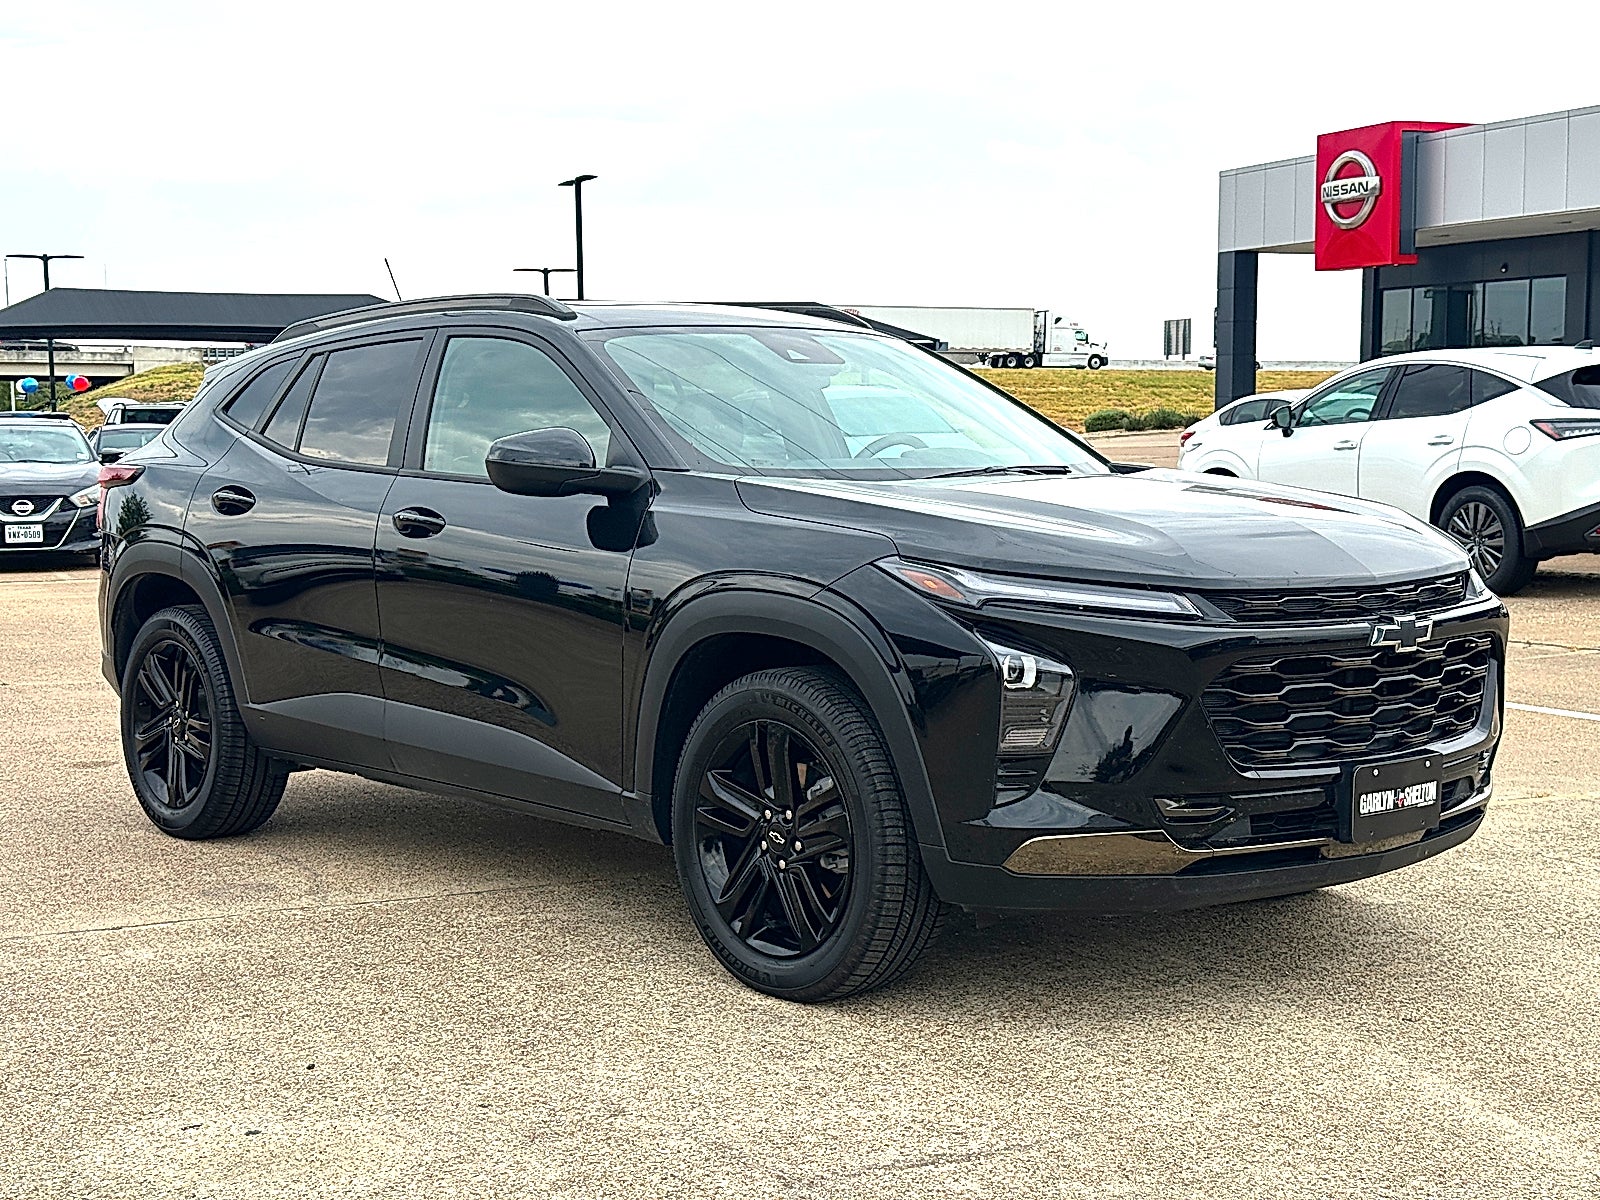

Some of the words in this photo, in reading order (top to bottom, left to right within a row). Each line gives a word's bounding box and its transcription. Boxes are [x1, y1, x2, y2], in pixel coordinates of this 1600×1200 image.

[1322, 181, 1369, 198] NISSAN
[775, 696, 833, 744] MICHELIN
[1360, 789, 1395, 814] GARLYN
[1404, 781, 1437, 807] SHELTON
